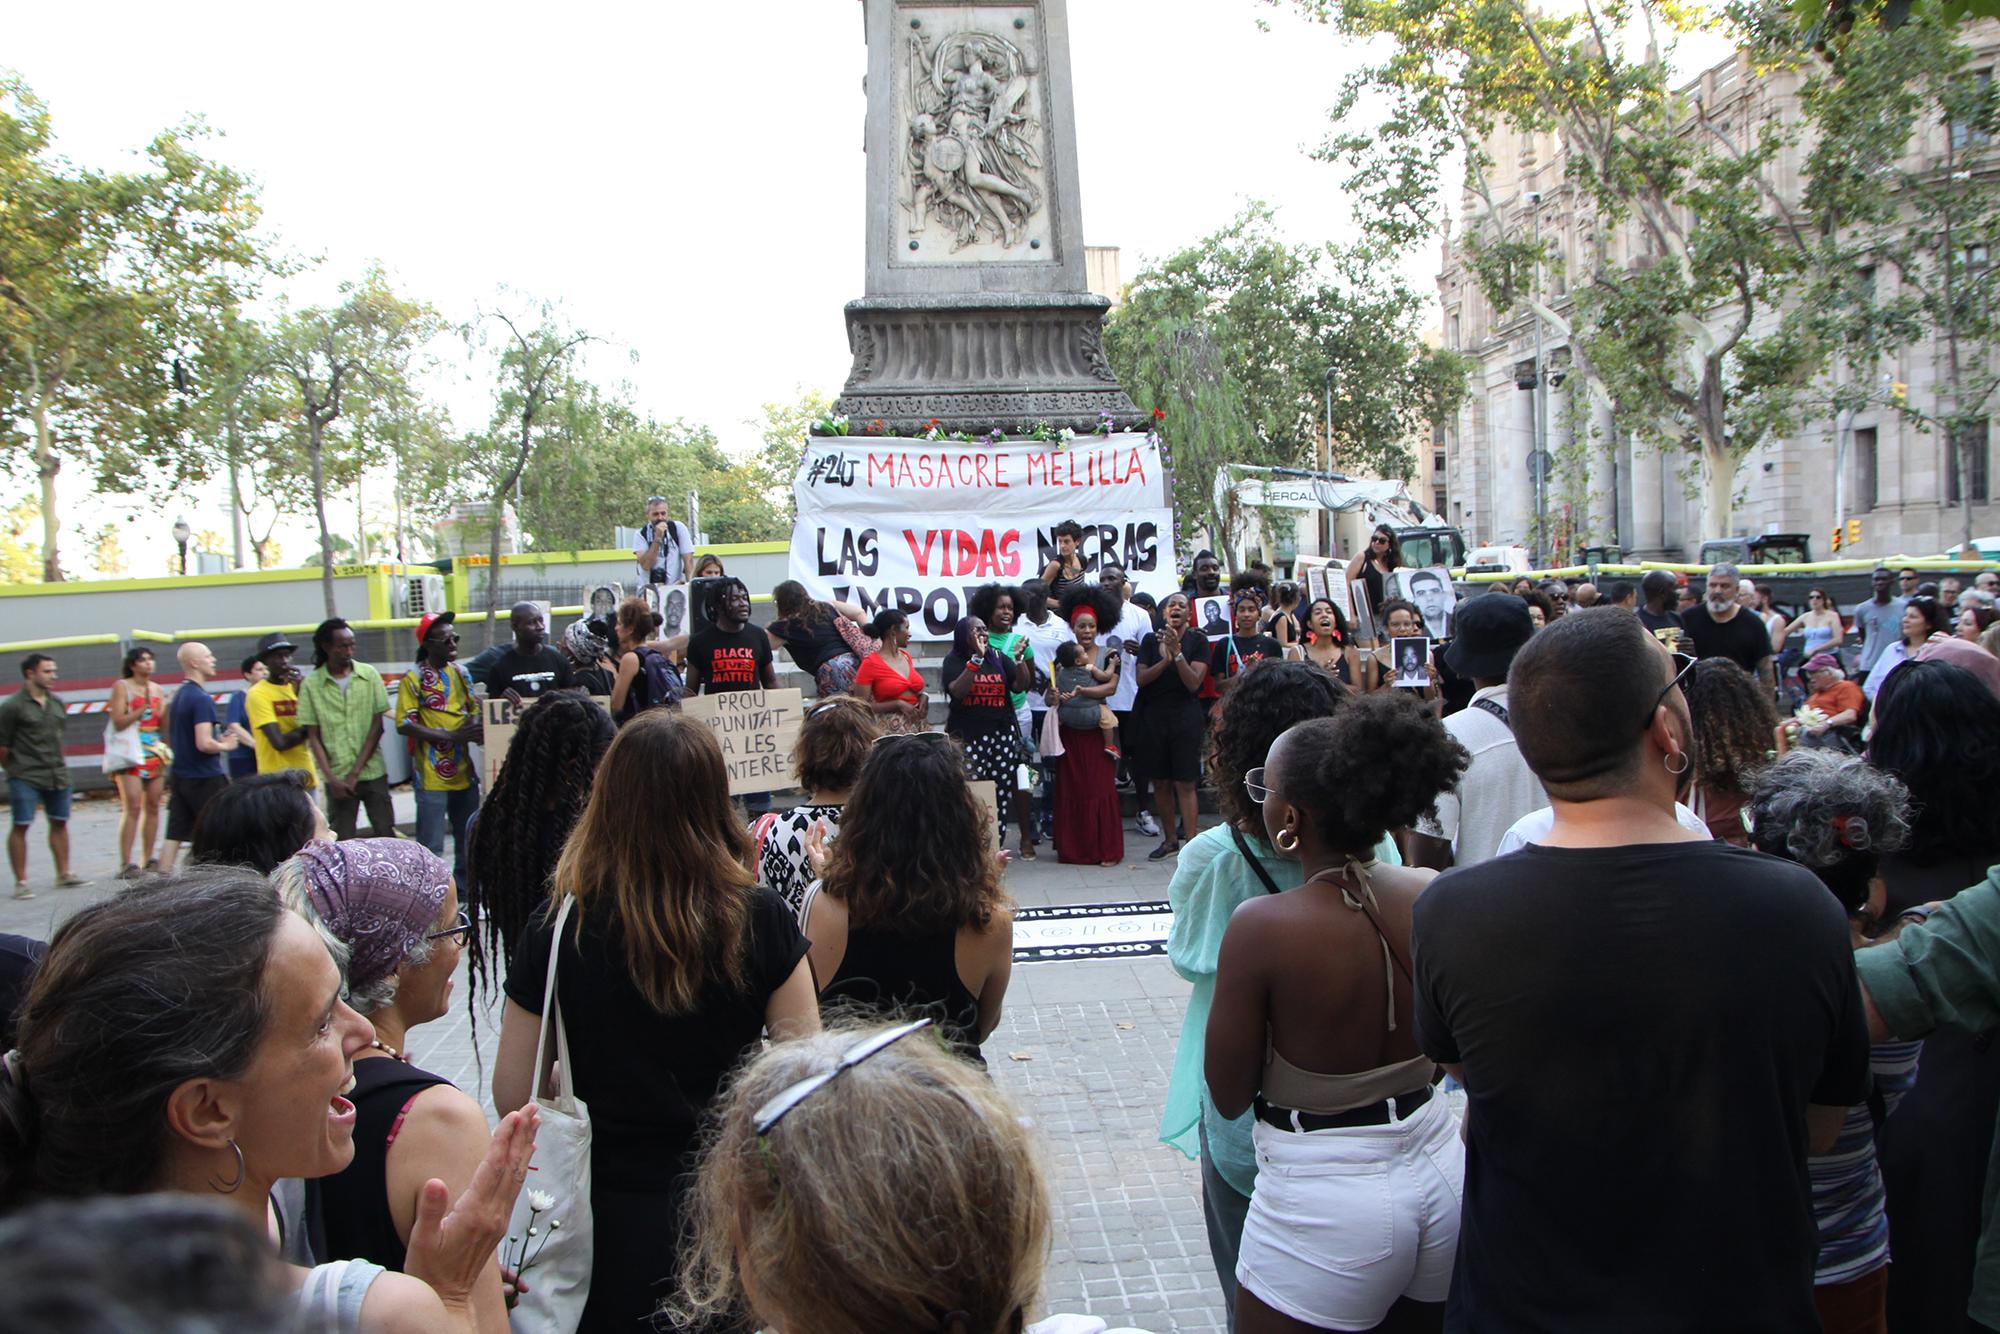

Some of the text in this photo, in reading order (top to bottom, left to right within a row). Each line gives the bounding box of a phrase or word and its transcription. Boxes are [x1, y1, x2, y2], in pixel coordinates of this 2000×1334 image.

[807, 447, 1146, 488] #24J MASACRE MELILLA
[816, 522, 1159, 577] LAS VIDAS NGRAS
[713, 647, 753, 659] BLACK
[714, 660, 753, 670] LIVES
[974, 673, 1003, 683] LACK
[718, 690, 766, 712] PROU
[963, 696, 1006, 707] MATTER
[723, 733, 776, 754] A LES
[1039, 943, 1152, 956] 500.000
